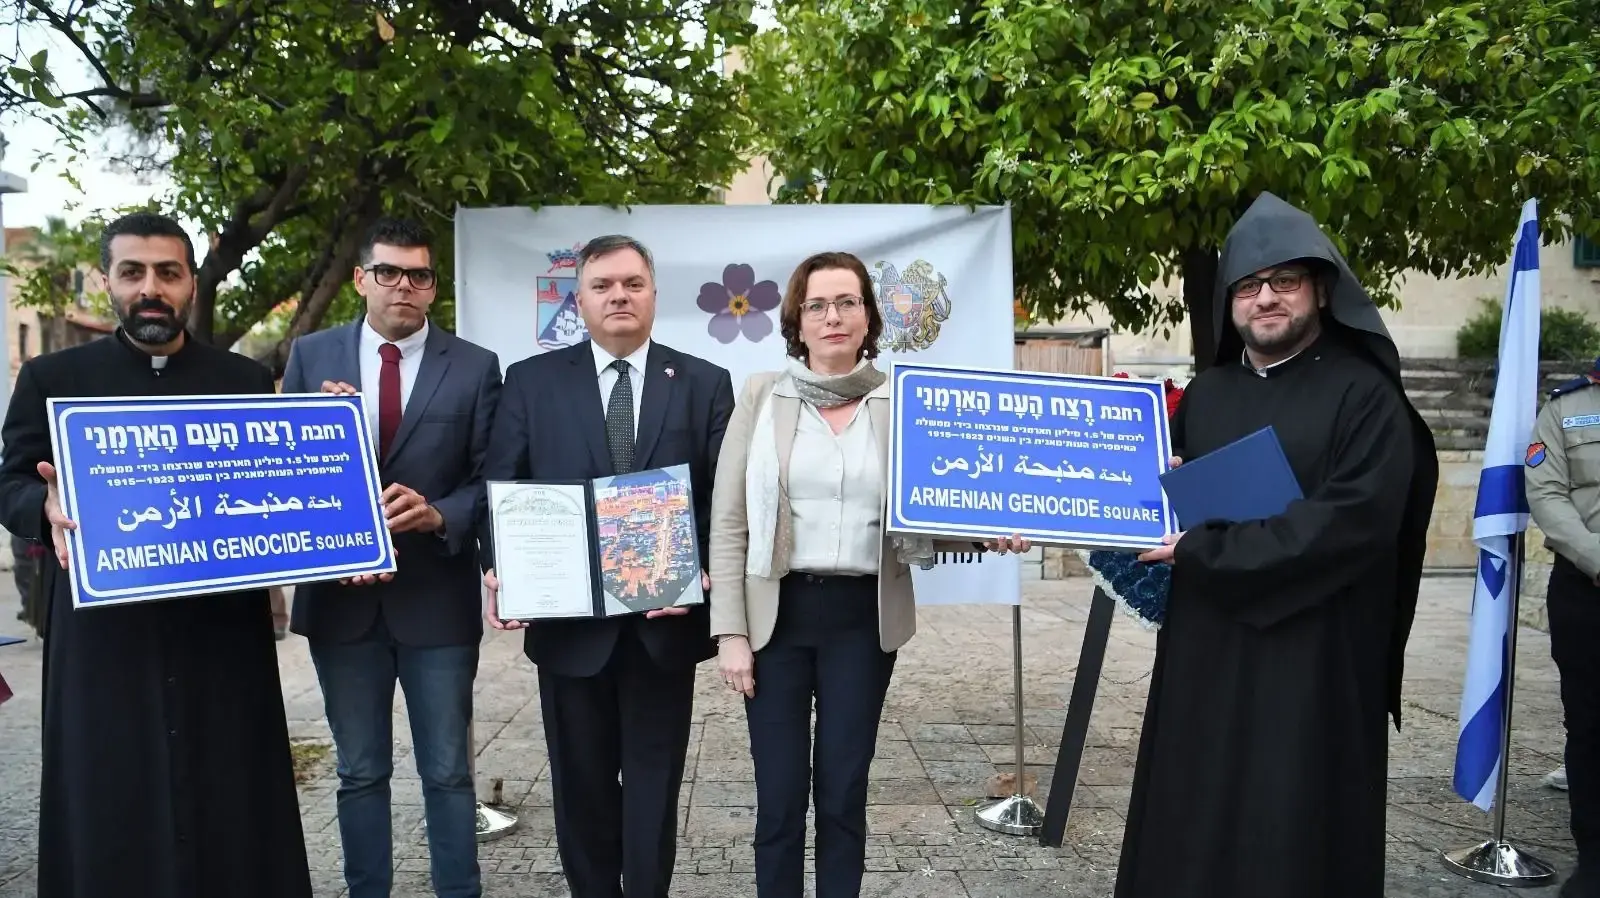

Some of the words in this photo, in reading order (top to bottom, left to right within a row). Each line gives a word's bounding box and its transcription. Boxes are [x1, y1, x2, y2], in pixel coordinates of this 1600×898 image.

[1101, 406, 1141, 421] רחבת
[301, 425, 345, 440] רחבת
[254, 456, 282, 468] מיליון
[286, 456, 302, 465] 1.5
[303, 454, 319, 464] של
[322, 453, 349, 462] לזכרם
[932, 445, 1003, 478] الأرمن
[90, 465, 133, 474] ממשלת
[137, 463, 159, 472] בידי
[162, 461, 202, 471] שנרצחו
[206, 459, 251, 469] הארמנים
[1014, 456, 1094, 482] مذبحة
[296, 466, 342, 475] האימפריה
[178, 473, 212, 483] השנים
[216, 473, 230, 482] בין
[1099, 469, 1132, 485] باحة
[215, 492, 303, 519] مذبحة
[308, 495, 341, 510] باحة
[910, 487, 1002, 511] ARMENIAN
[1009, 494, 1100, 517] GENOCIDE
[1104, 506, 1159, 521] SQUARE
[118, 489, 201, 531] الأرمن
[97, 541, 208, 571] ARMENIAN
[213, 531, 313, 559] GENOCIDE
[316, 532, 373, 550] SQUARE
